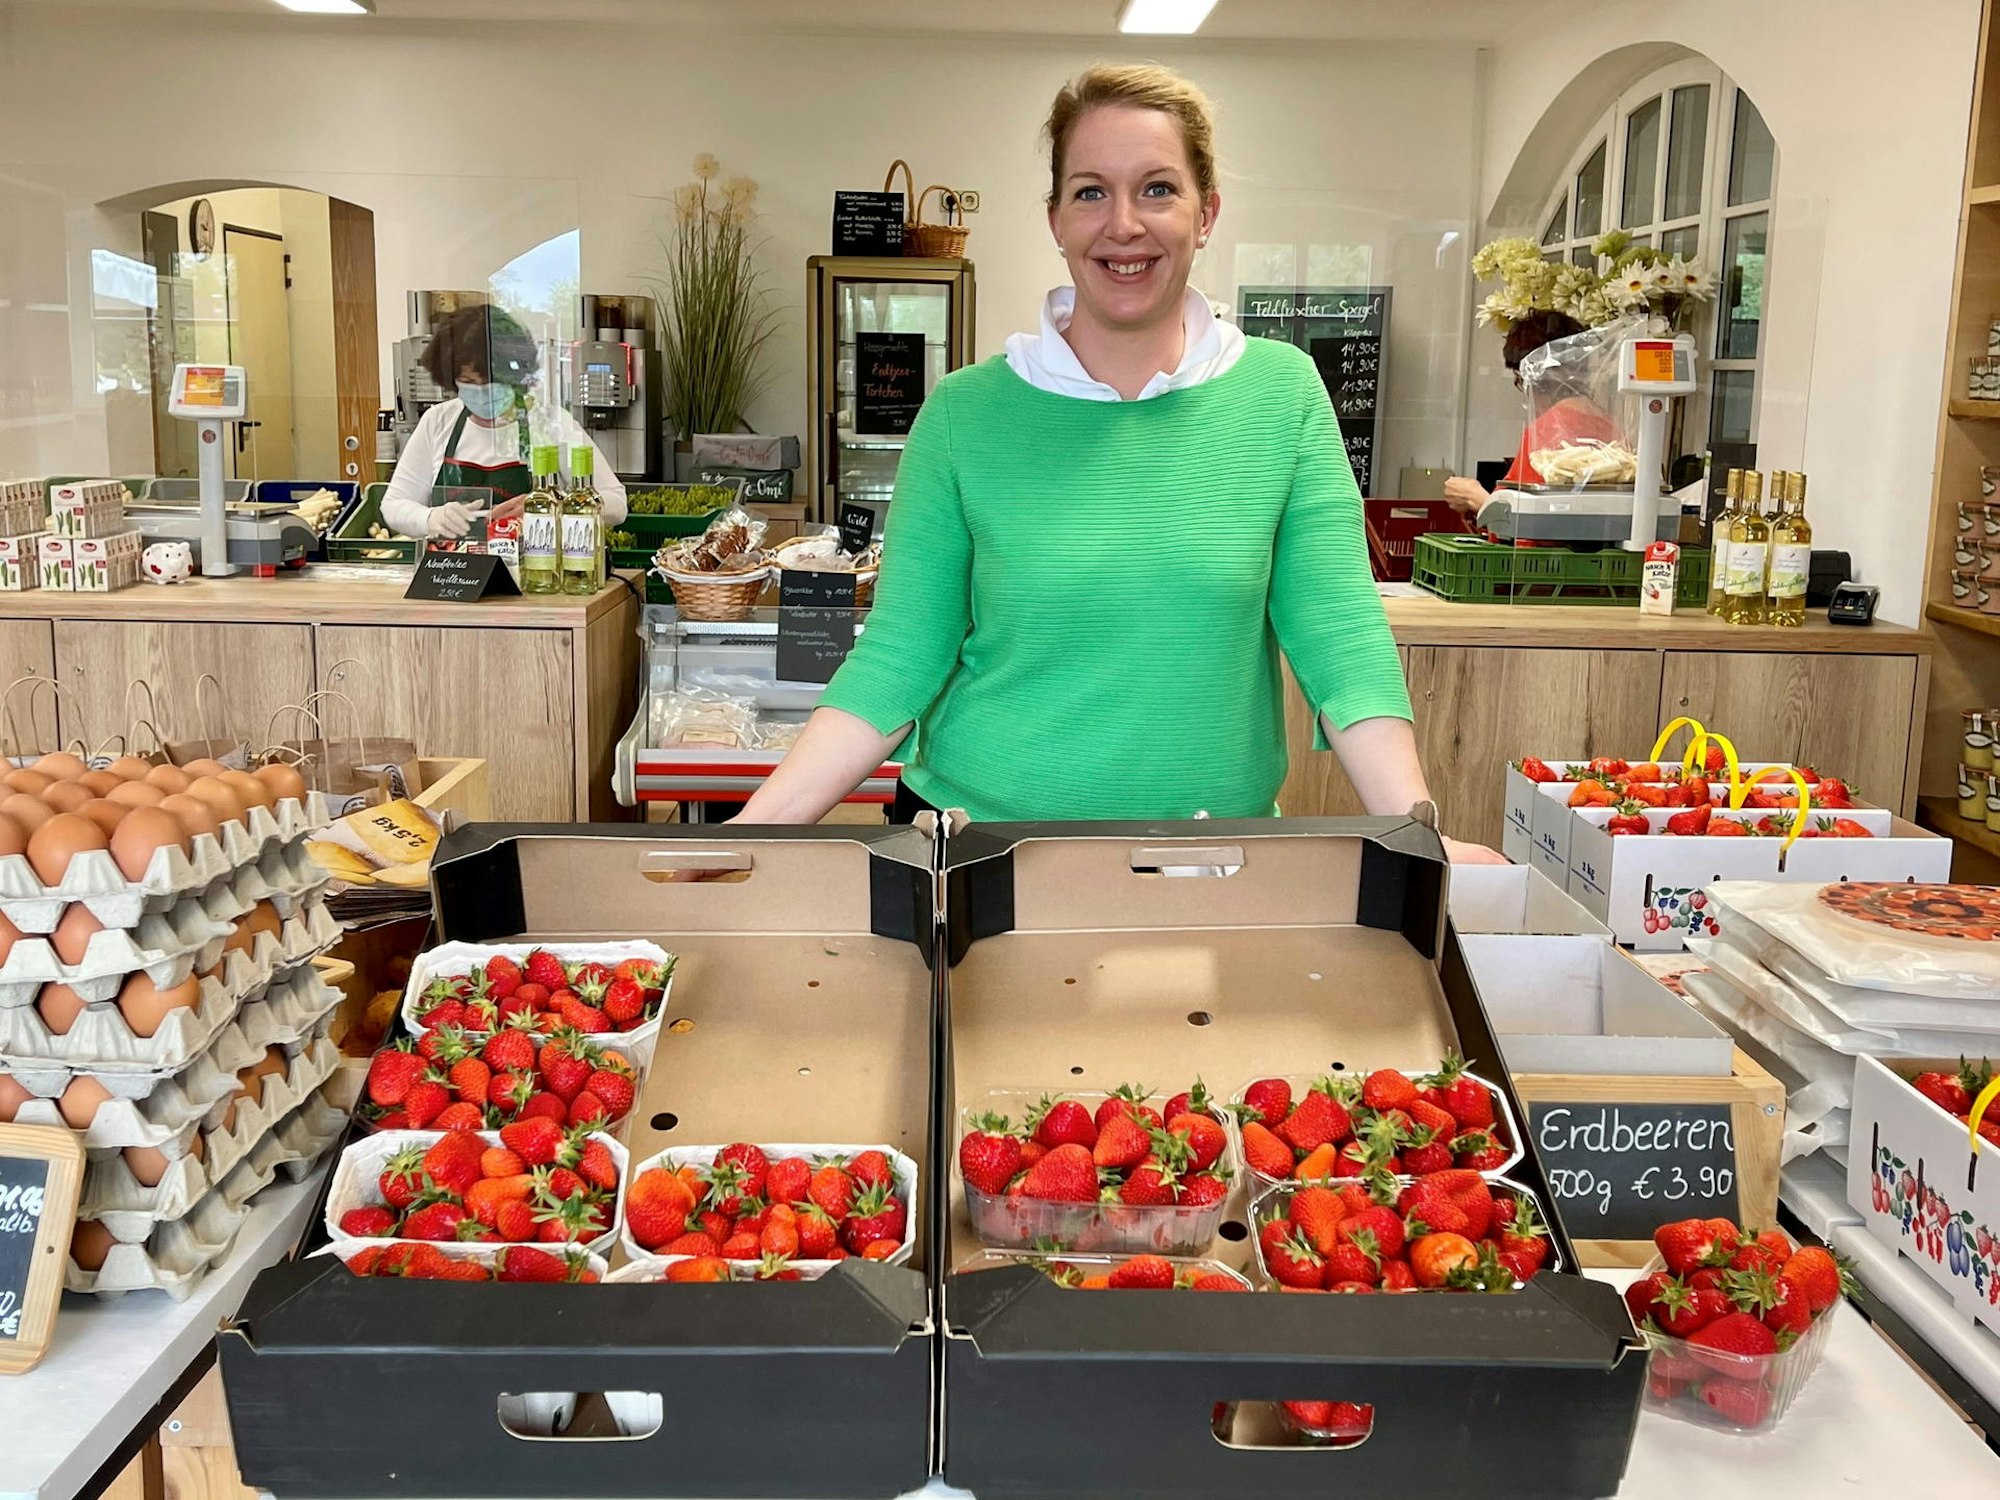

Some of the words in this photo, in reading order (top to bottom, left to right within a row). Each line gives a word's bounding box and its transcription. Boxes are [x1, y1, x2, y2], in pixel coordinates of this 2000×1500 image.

[757, 478, 783, 499] Omi
[847, 513, 869, 528] Wild
[371, 816, 401, 832] kg
[1539, 1107, 1735, 1153] Erdbeeren
[1549, 1168, 1613, 1215] 500g
[1630, 1168, 1660, 1200] €
[1663, 1167, 1734, 1199] 3.90
